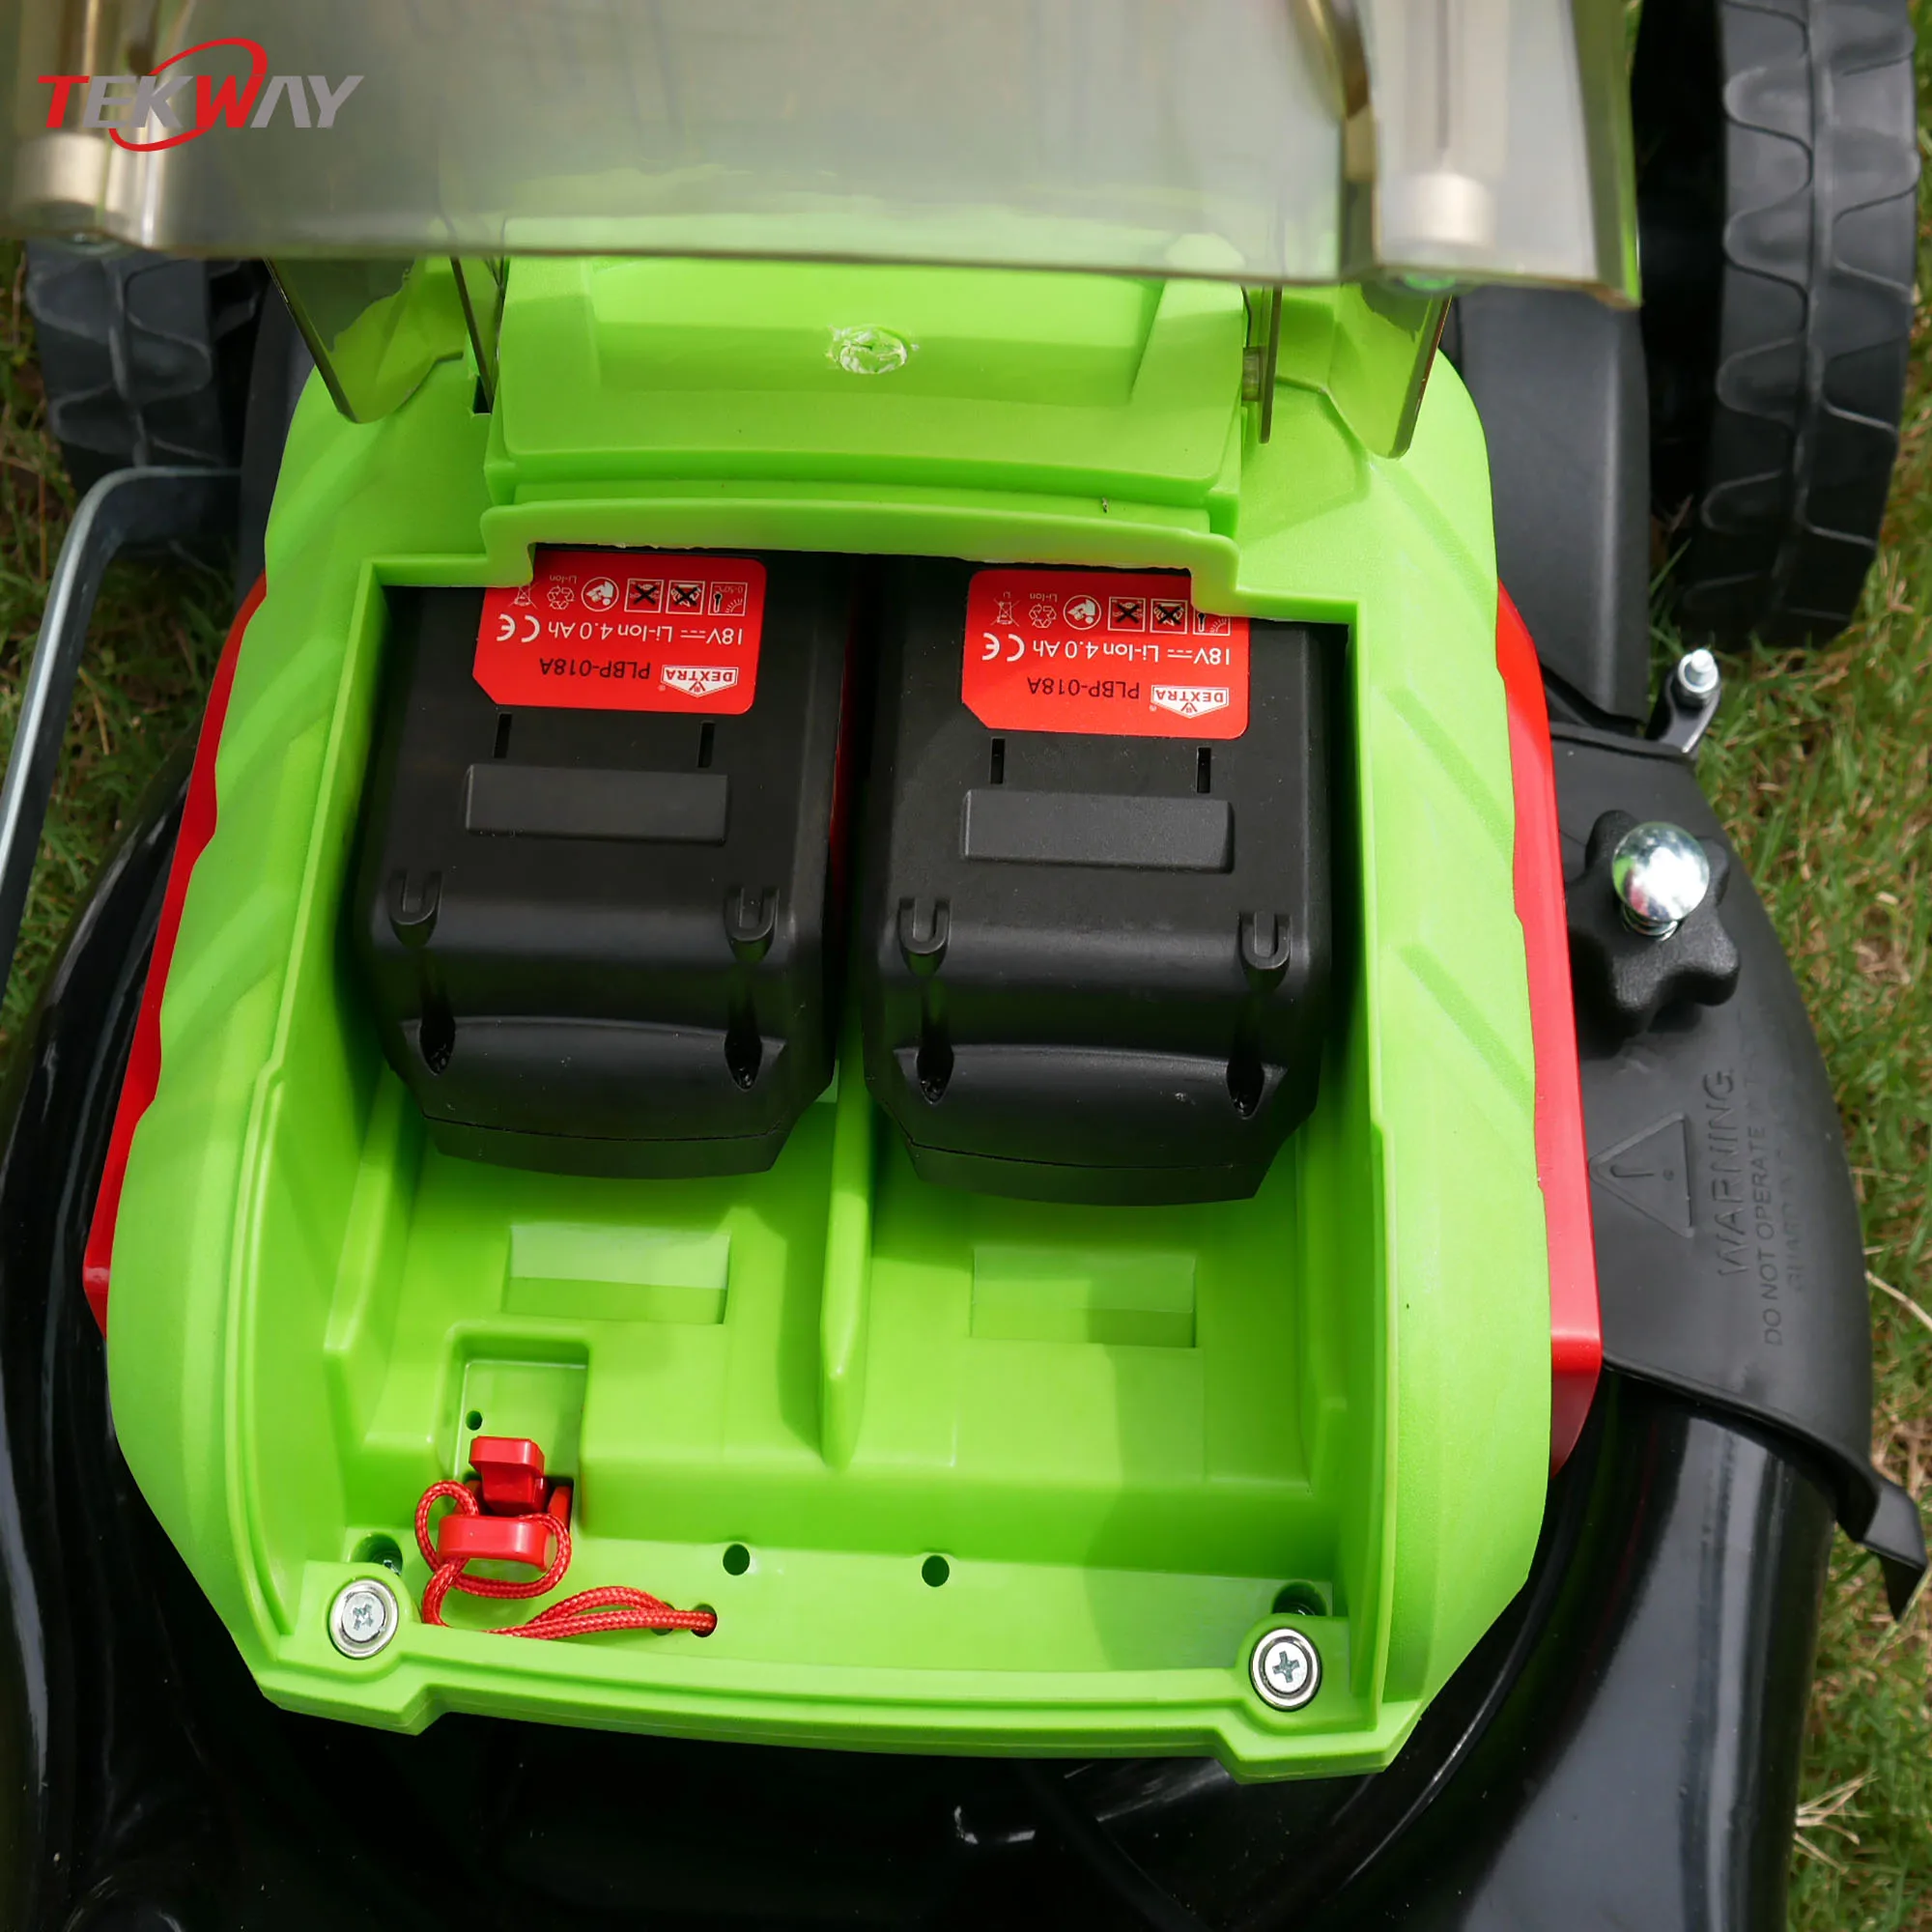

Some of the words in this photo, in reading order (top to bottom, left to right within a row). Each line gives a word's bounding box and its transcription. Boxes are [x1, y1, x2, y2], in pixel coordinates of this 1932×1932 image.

[548, 620, 576, 639] Ah
[580, 621, 613, 640] 4.0
[617, 623, 673, 642] Li-Ion
[706, 627, 744, 646] 18V
[1032, 639, 1061, 657] Ah
[1065, 640, 1099, 660] 4.0
[1102, 643, 1159, 663] Li-Ion
[1193, 646, 1232, 666] 18V
[539, 657, 651, 680] PLBP-018A
[665, 668, 734, 683] DEXTRA
[1027, 676, 1141, 699] PLBP-018A
[1154, 690, 1225, 703] DEXTRA
[1702, 1070, 1750, 1277] WARNING
[1747, 1124, 1776, 1241] OPERATE
[1757, 1248, 1779, 1300] NOT
[1763, 1308, 1783, 1347] DO
